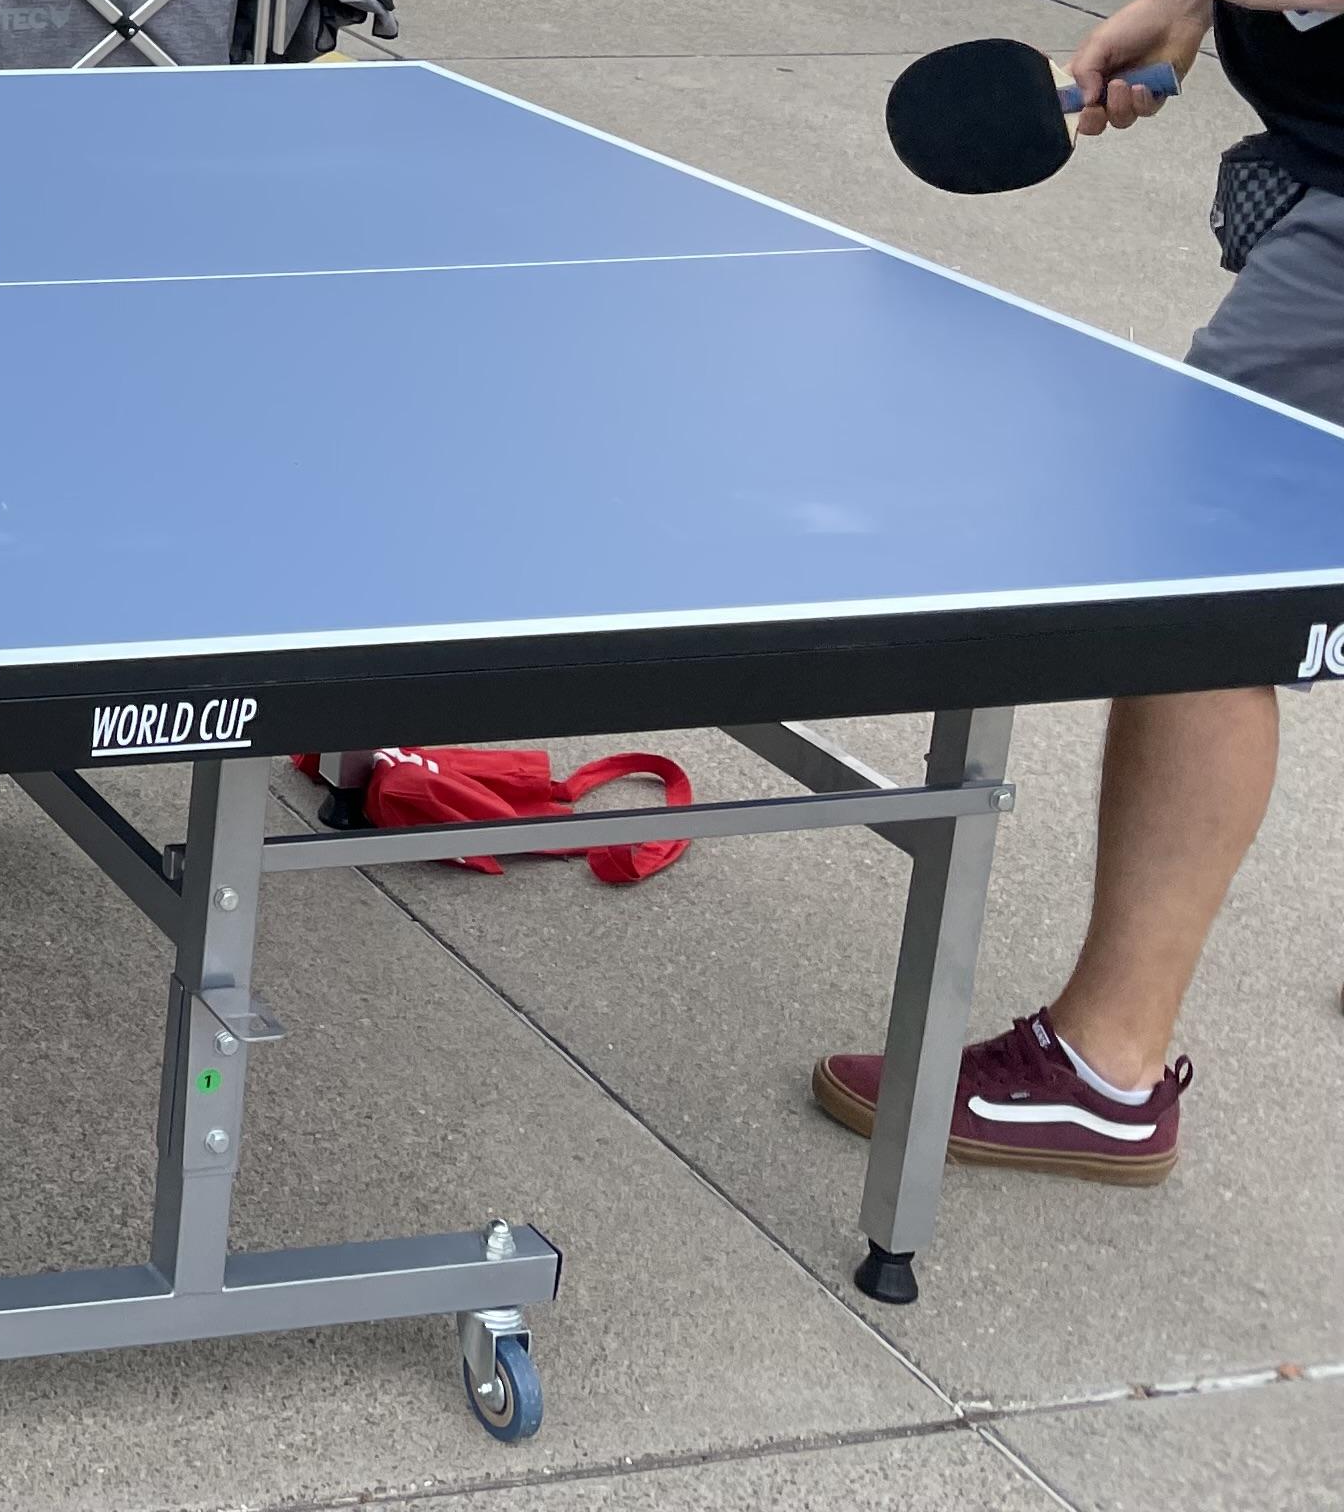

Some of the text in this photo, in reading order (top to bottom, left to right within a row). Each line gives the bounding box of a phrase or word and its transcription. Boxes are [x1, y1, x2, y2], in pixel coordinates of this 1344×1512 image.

[92, 698, 258, 748] WORLD CUP
[203, 1074, 212, 1089] 1
